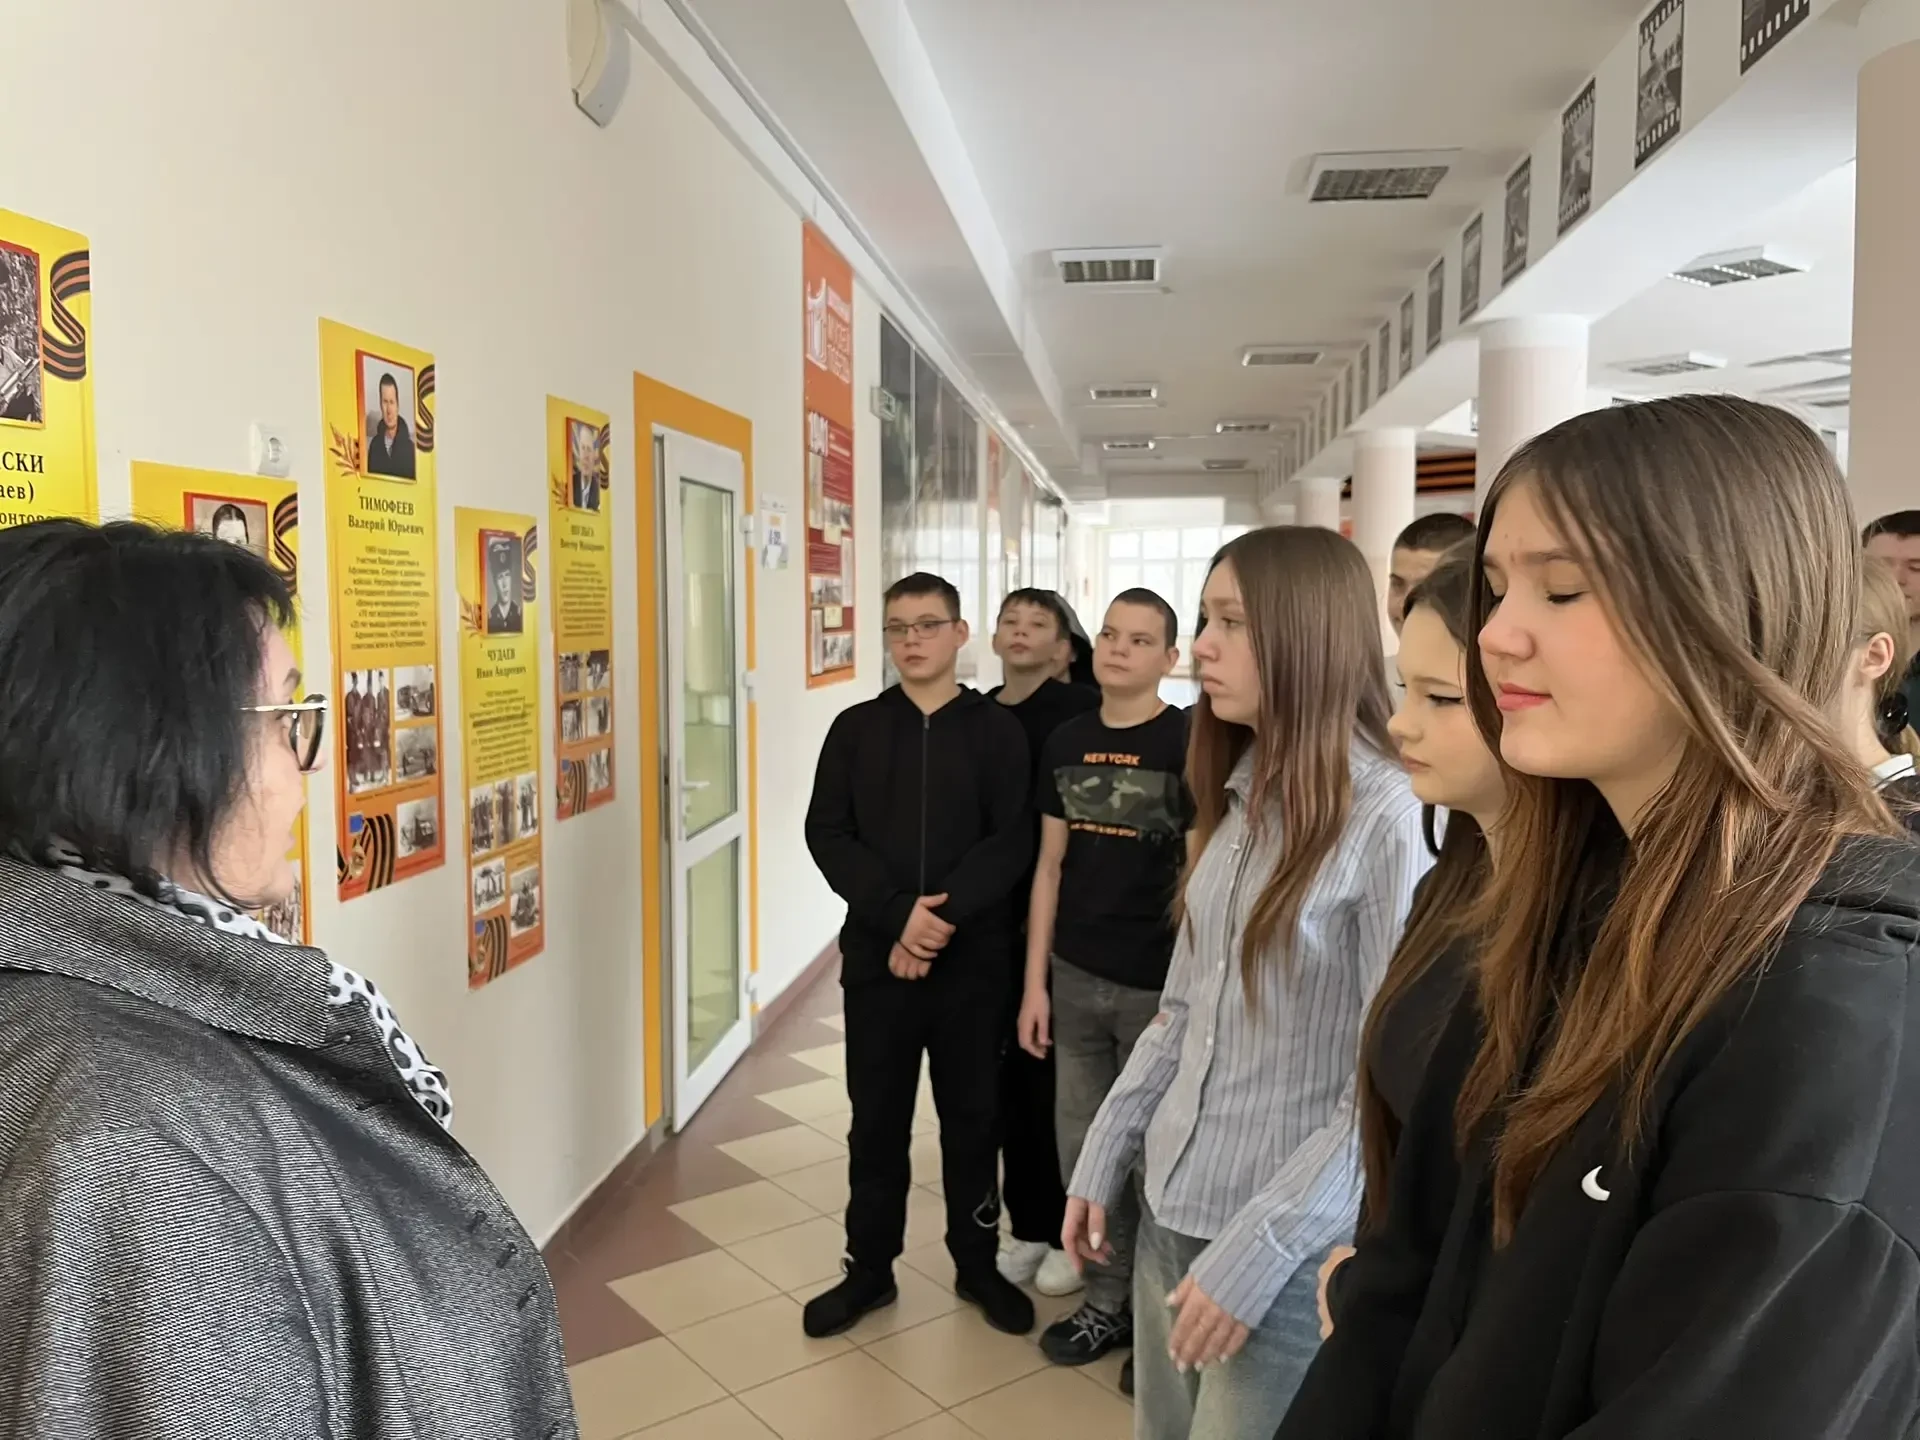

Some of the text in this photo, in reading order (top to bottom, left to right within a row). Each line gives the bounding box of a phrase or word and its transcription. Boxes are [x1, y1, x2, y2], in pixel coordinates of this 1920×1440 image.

[0, 451, 44, 474] СКИ
[359, 495, 414, 515] ТИМОФЕЕВ
[348, 514, 424, 536] Валерий Юрьевич
[487, 648, 516, 661] ЧУДАЕВ
[1083, 752, 1140, 766] NEW YORK
